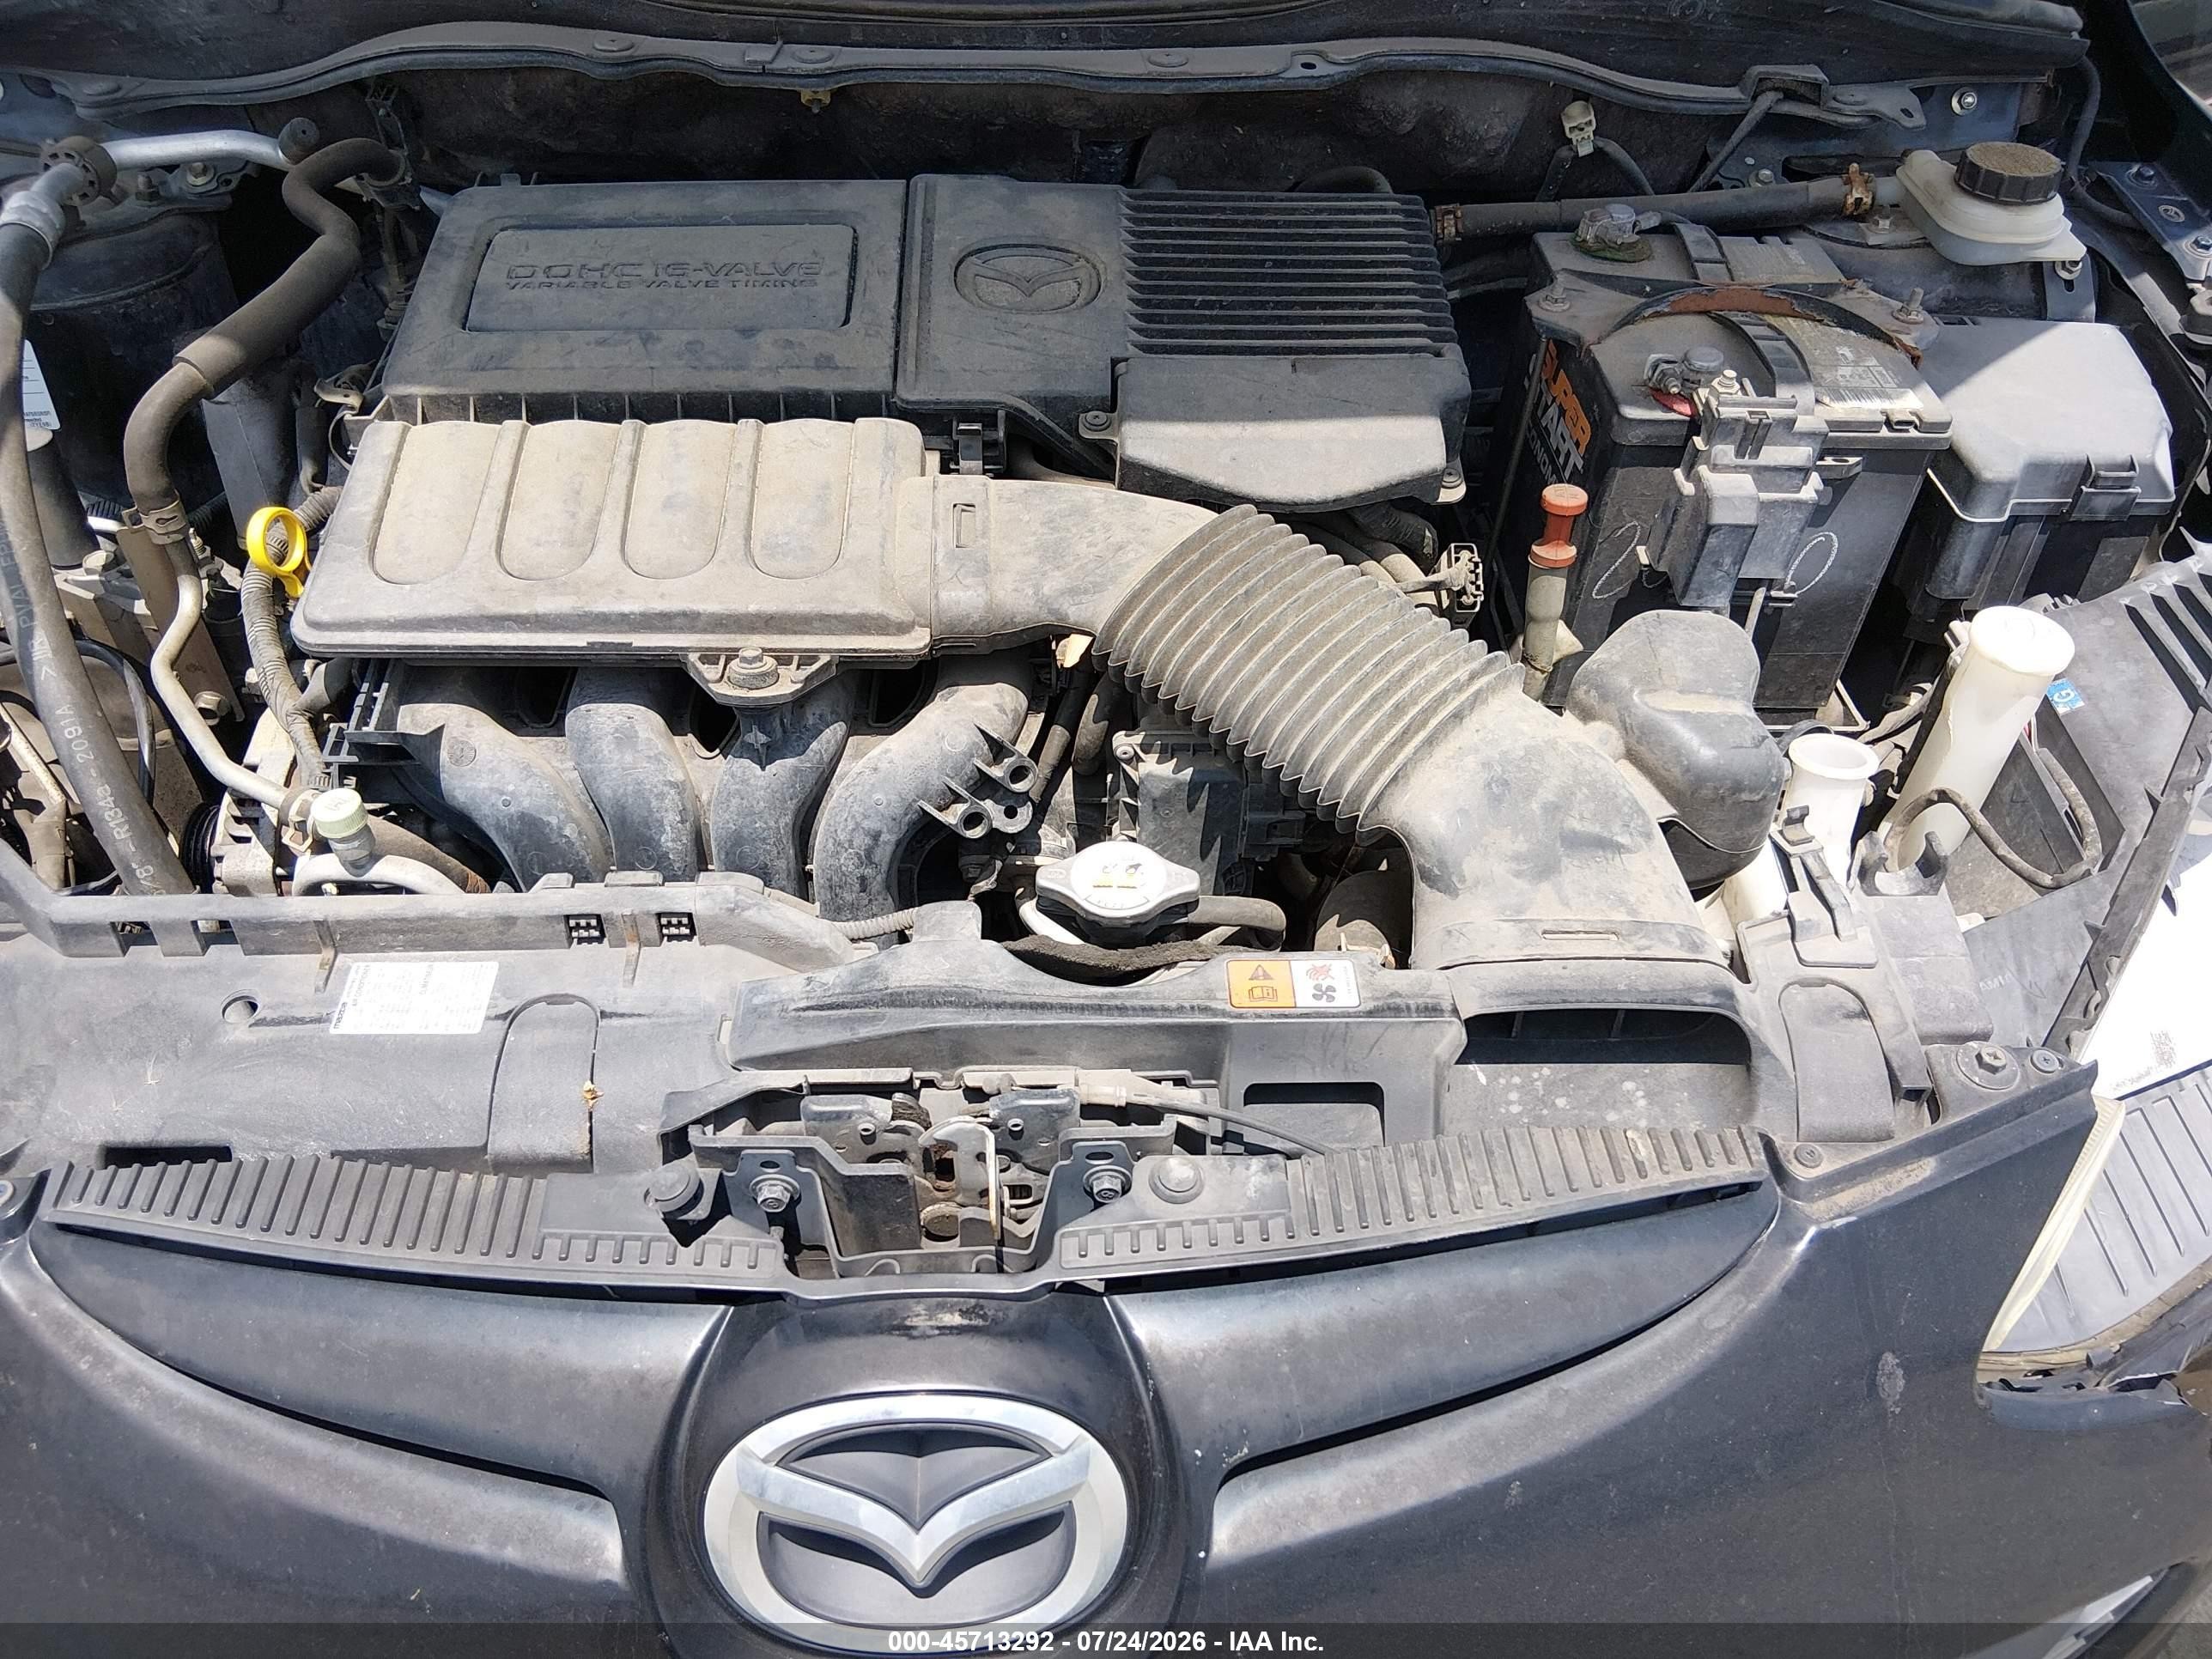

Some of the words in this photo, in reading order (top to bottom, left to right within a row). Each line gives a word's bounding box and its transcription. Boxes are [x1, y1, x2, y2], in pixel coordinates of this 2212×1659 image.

[507, 262, 644, 280] DOHC
[653, 261, 822, 279] 16-VALVE
[507, 280, 633, 290] VARIABLE
[645, 279, 720, 289] VALVE
[728, 279, 819, 289] TIMING
[54, 703, 94, 763] 2091A
[96, 784, 133, 841] R134a
[333, 1001, 348, 1030] mazda
